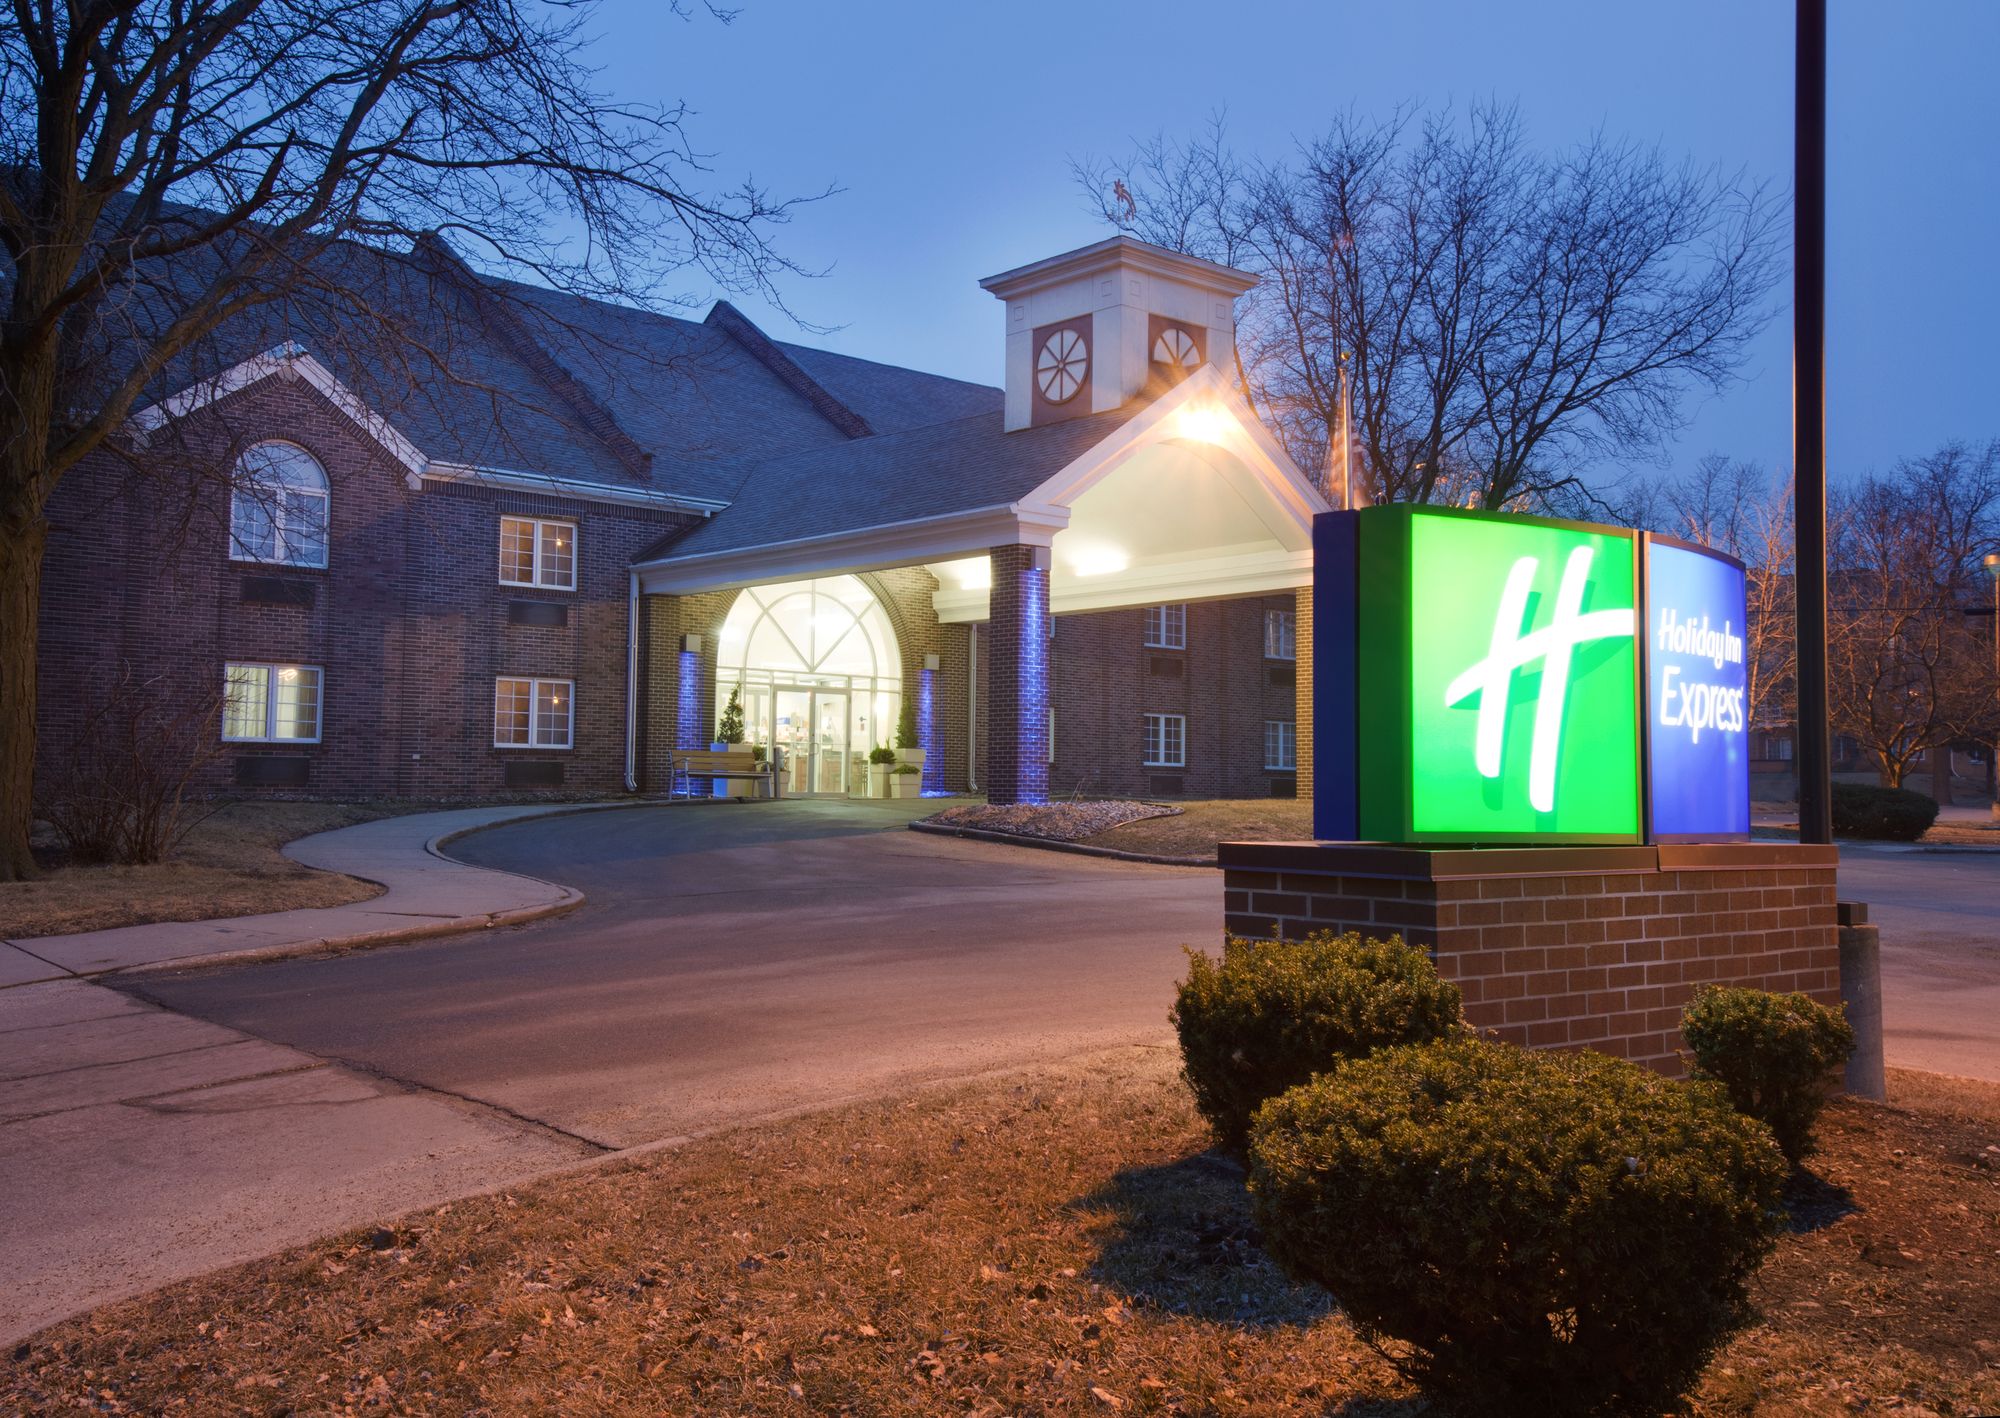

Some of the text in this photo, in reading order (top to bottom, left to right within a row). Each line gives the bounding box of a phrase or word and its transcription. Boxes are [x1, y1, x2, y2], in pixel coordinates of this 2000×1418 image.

[1658, 607, 1742, 669] Holiday Inn
[1445, 545, 1634, 812] H
[1660, 665, 1743, 744] Express
